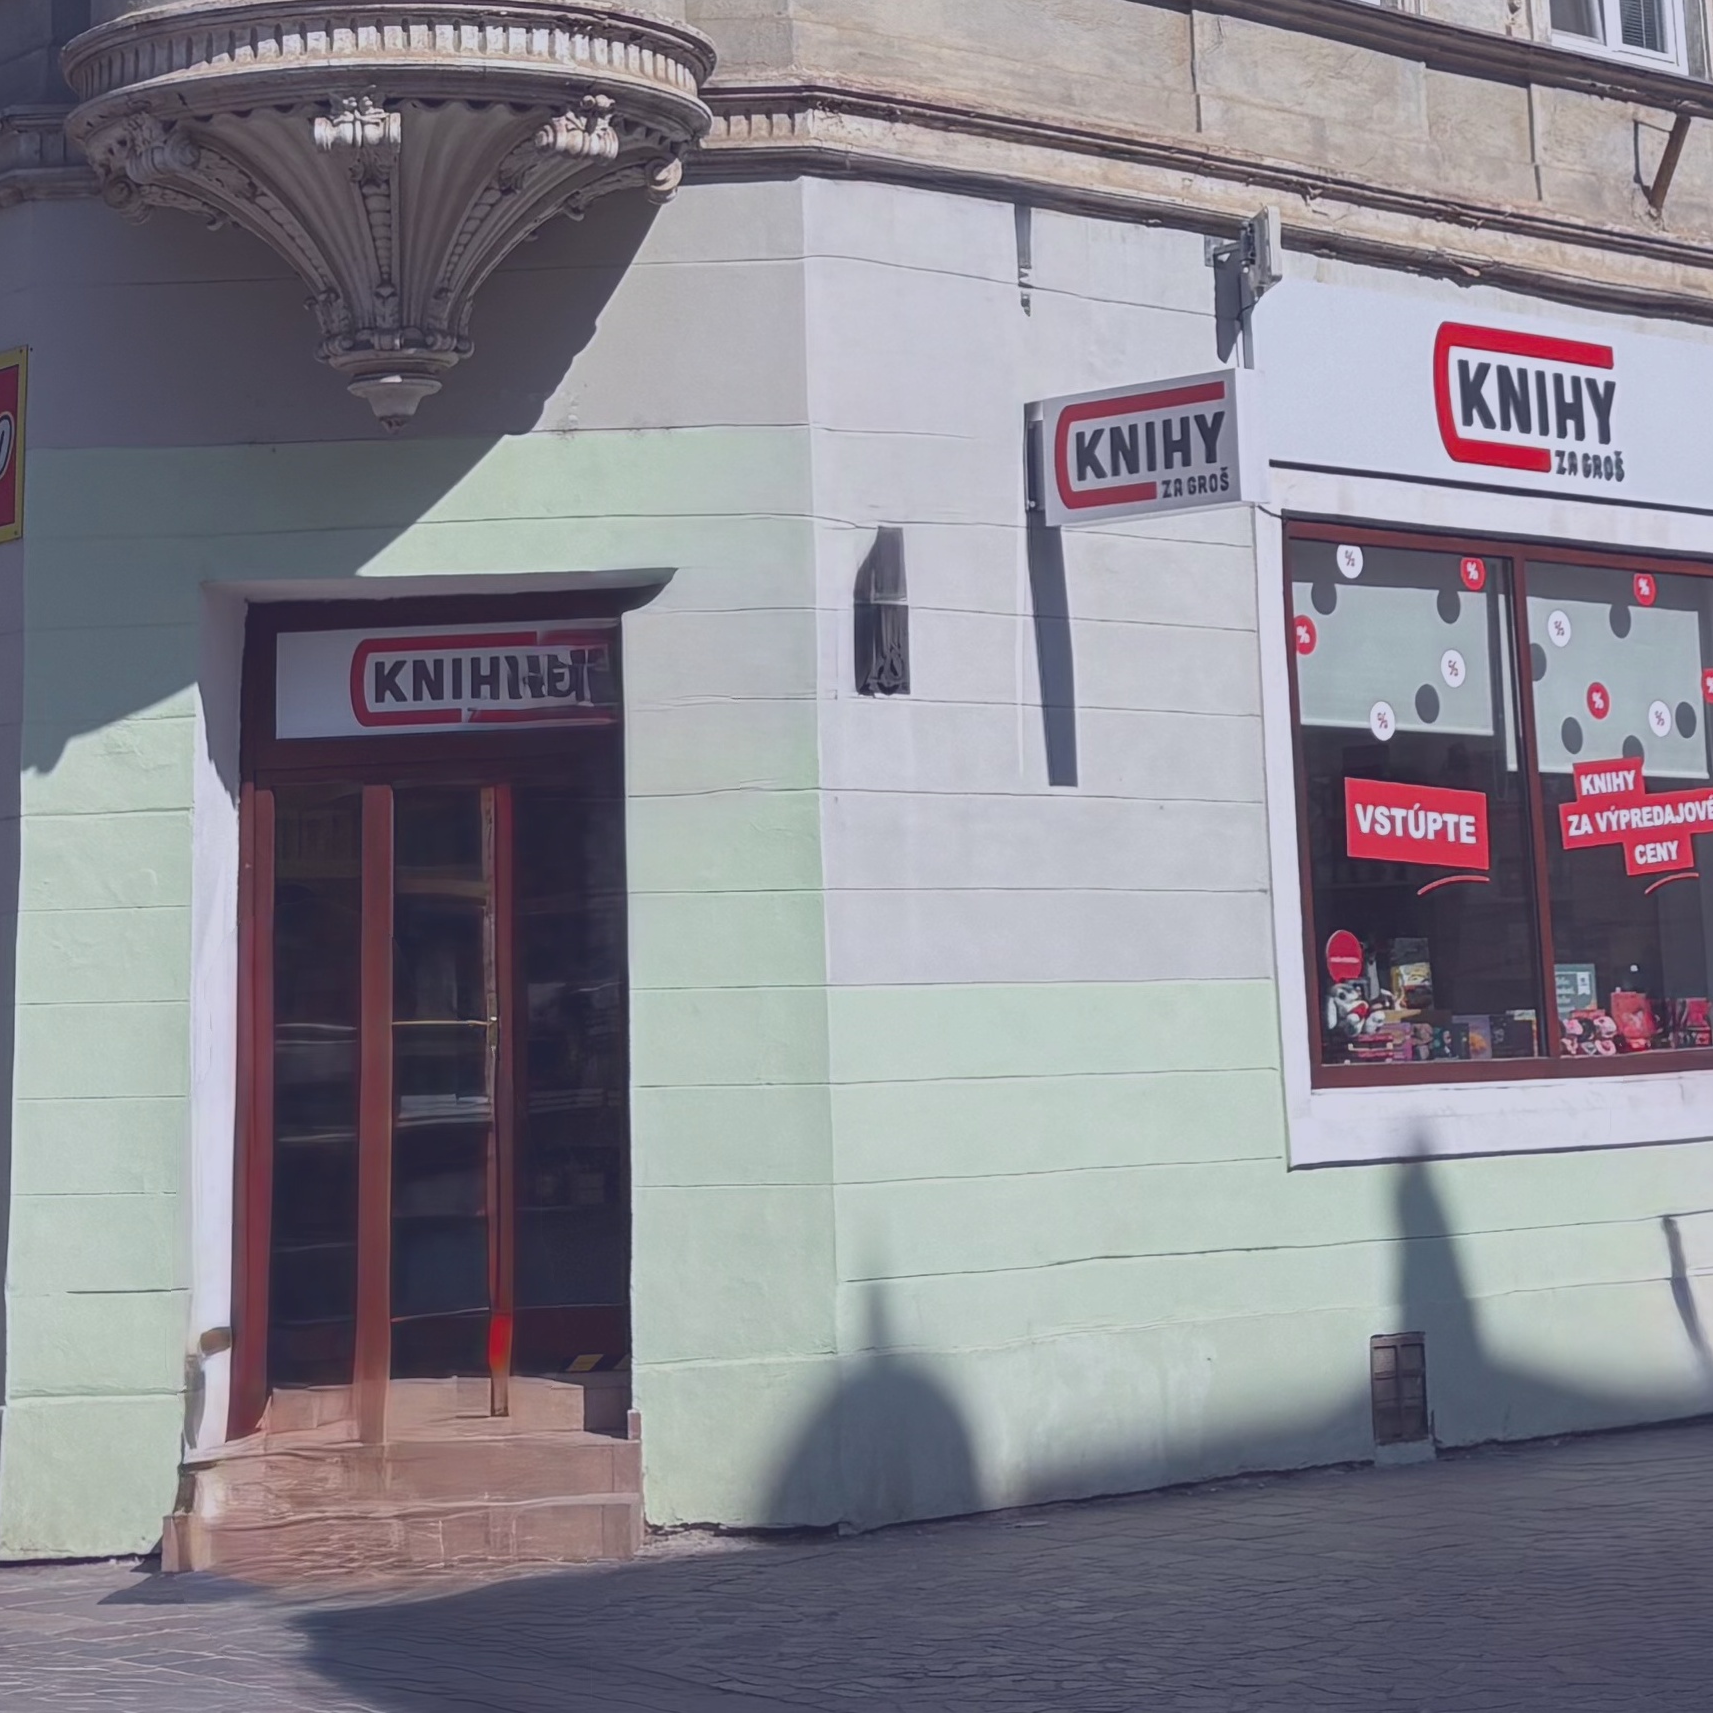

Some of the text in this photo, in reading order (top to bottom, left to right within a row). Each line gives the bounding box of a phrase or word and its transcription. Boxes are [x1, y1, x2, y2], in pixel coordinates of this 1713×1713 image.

[1457, 358, 1616, 445] KNIHY
[1075, 411, 1225, 481] KNIHY
[1555, 450, 1625, 482] ZA GROŠ
[1161, 466, 1229, 499] ZA GROŠ
[1580, 769, 1636, 796] KNIHY
[1354, 798, 1477, 845] VSTÚPTE
[1567, 814, 1593, 836] ZA
[1634, 840, 1679, 865] CENY
